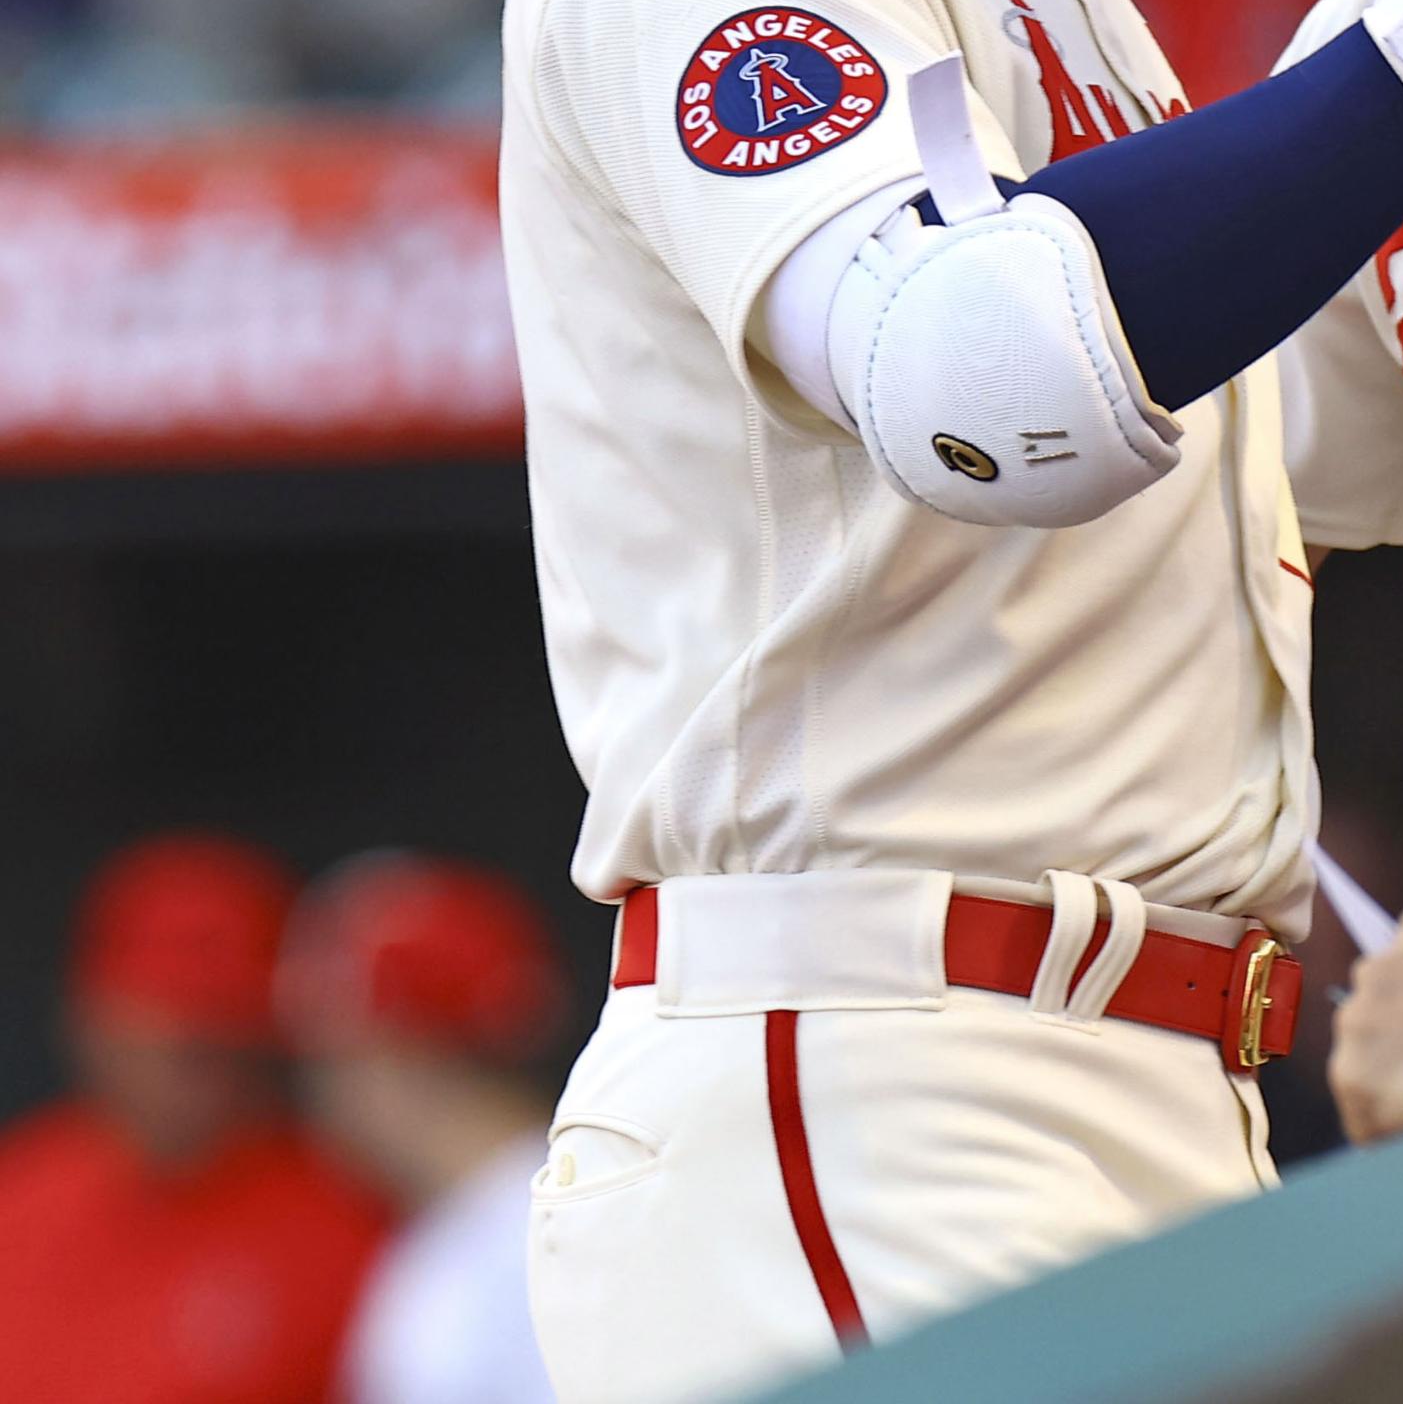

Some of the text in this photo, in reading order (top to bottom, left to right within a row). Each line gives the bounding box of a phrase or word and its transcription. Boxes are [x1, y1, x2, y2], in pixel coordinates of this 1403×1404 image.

[683, 14, 875, 149] LOS ANGELES
[721, 95, 874, 167] ANGELS
